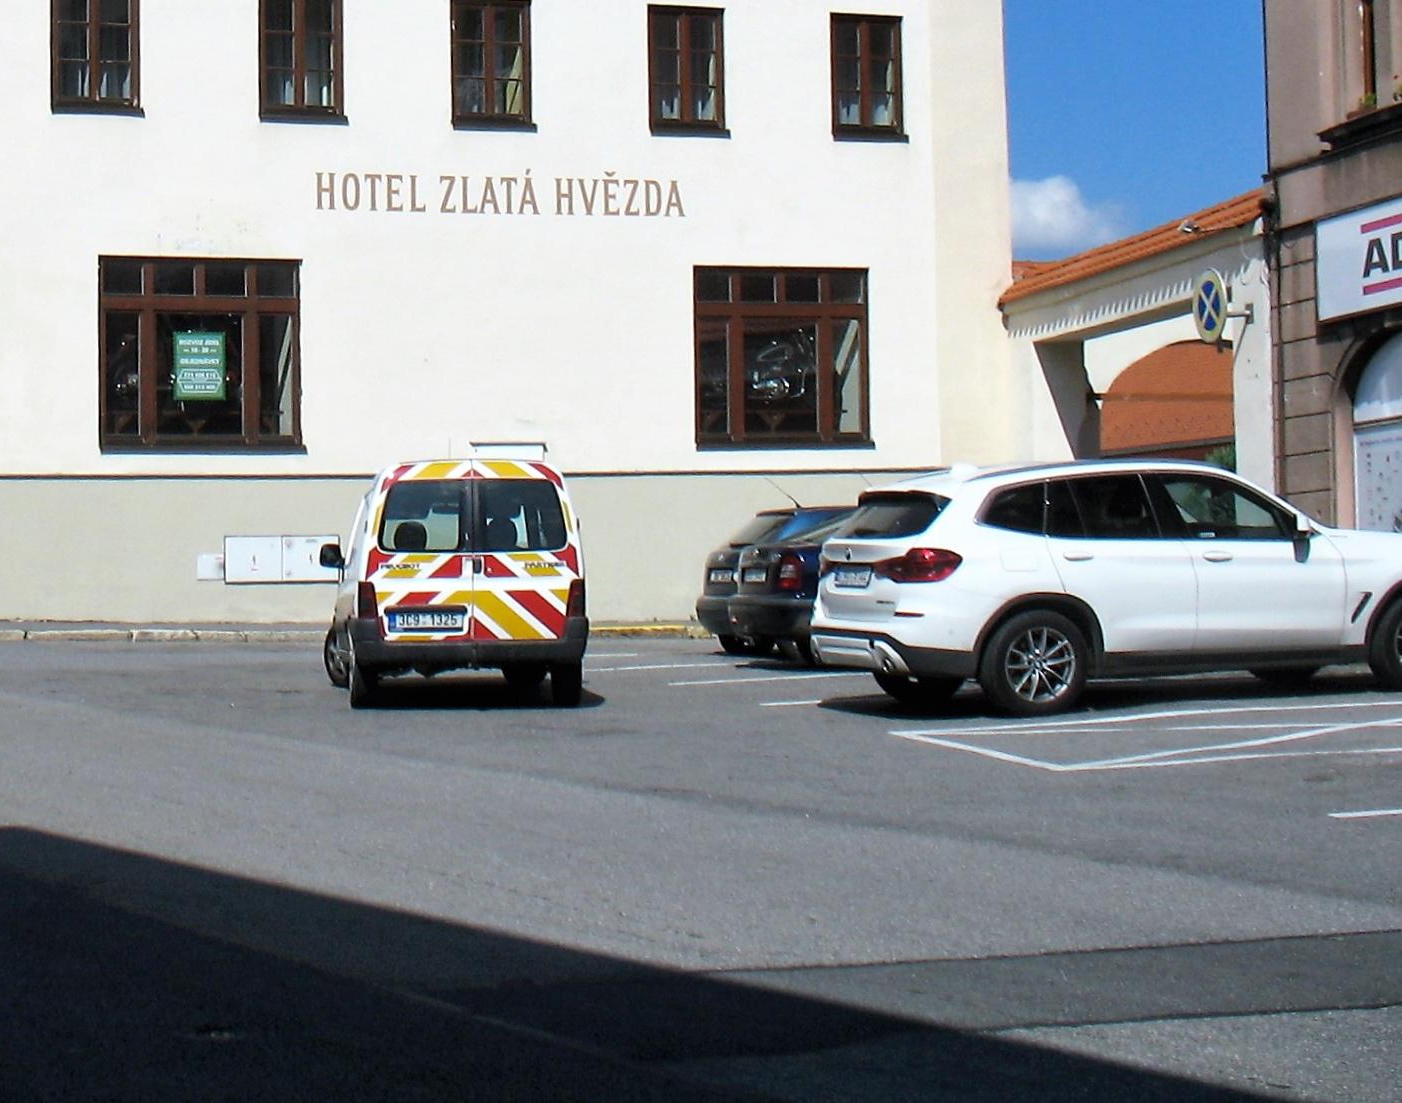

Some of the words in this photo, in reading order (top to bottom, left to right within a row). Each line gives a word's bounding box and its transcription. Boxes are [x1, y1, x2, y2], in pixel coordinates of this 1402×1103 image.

[315, 171, 427, 213] HOTEL
[439, 168, 541, 215] ZLATÁ
[554, 171, 687, 218] HVĚZDA
[399, 614, 420, 626] 3C9
[430, 615, 458, 626] 1325
